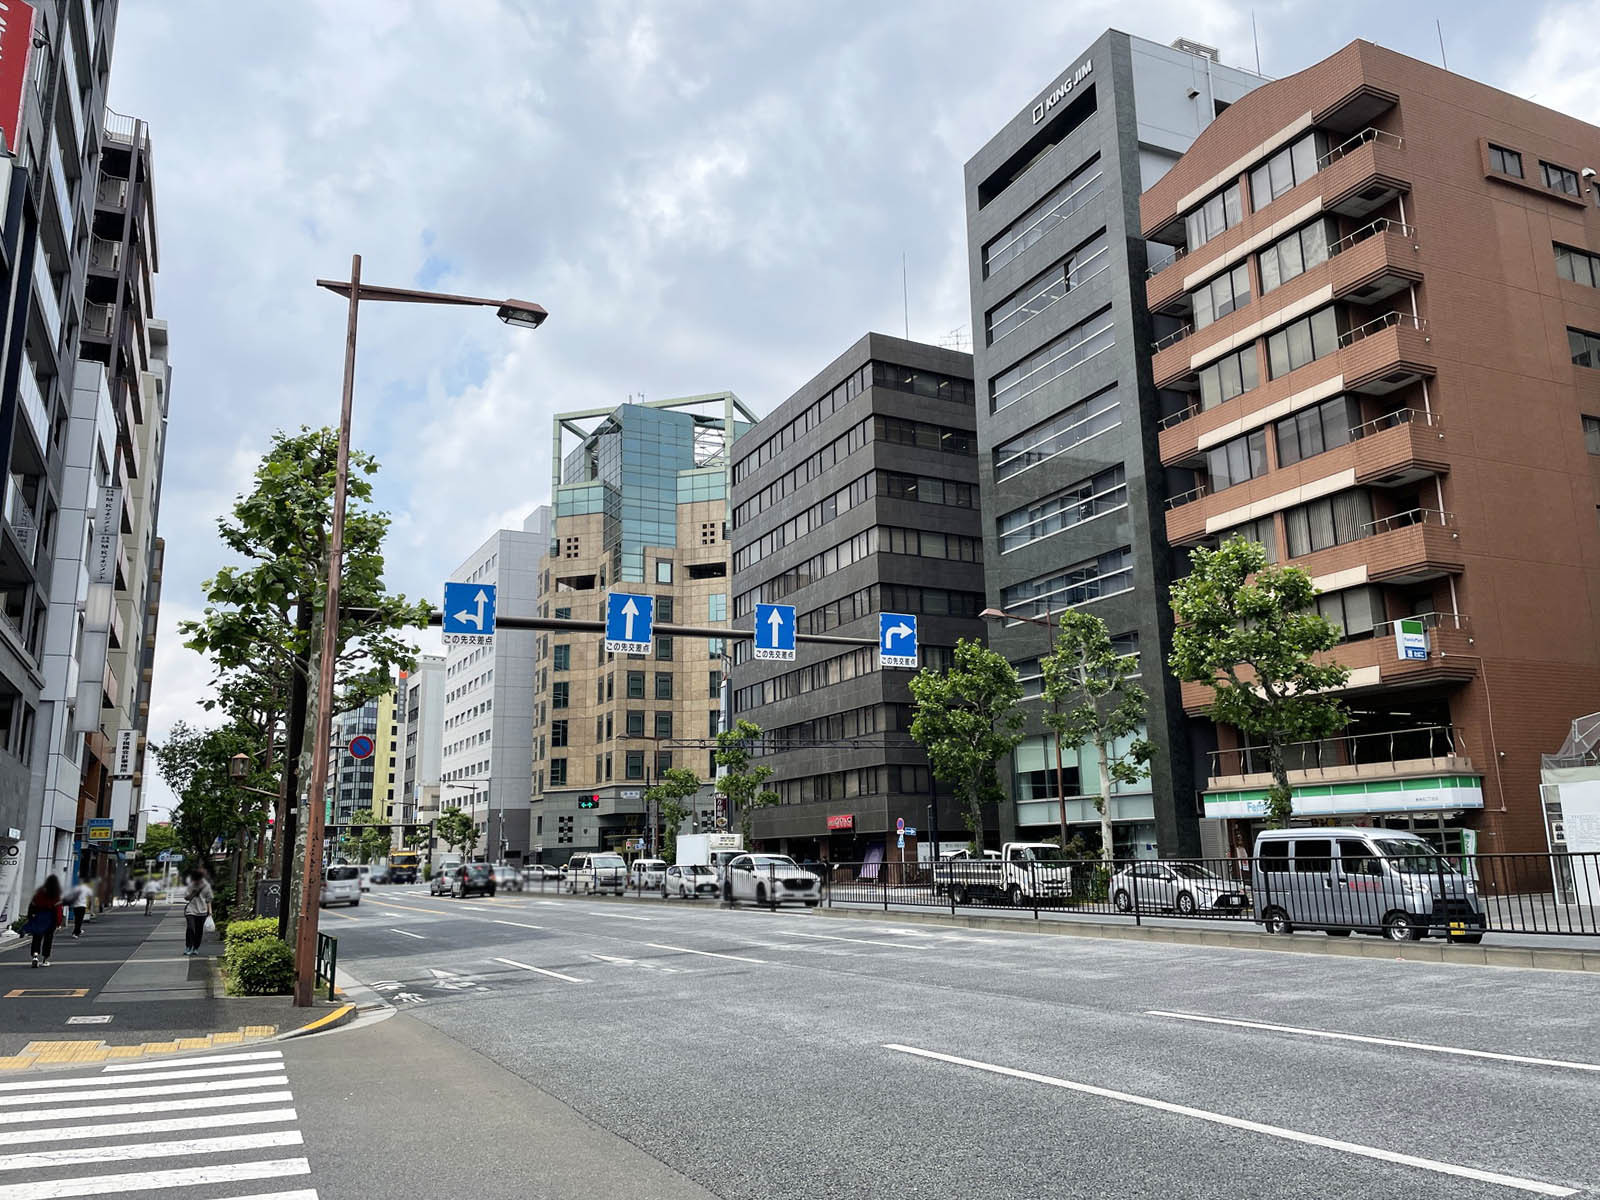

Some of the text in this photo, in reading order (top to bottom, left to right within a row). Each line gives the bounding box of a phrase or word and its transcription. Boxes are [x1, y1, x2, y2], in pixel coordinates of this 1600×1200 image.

[1046, 59, 1093, 111] KING JIM
[443, 635, 493, 645] この先交差点
[606, 642, 650, 653] この先交差点
[756, 650, 794, 659] この先交差点
[881, 656, 916, 665] この先交差点
